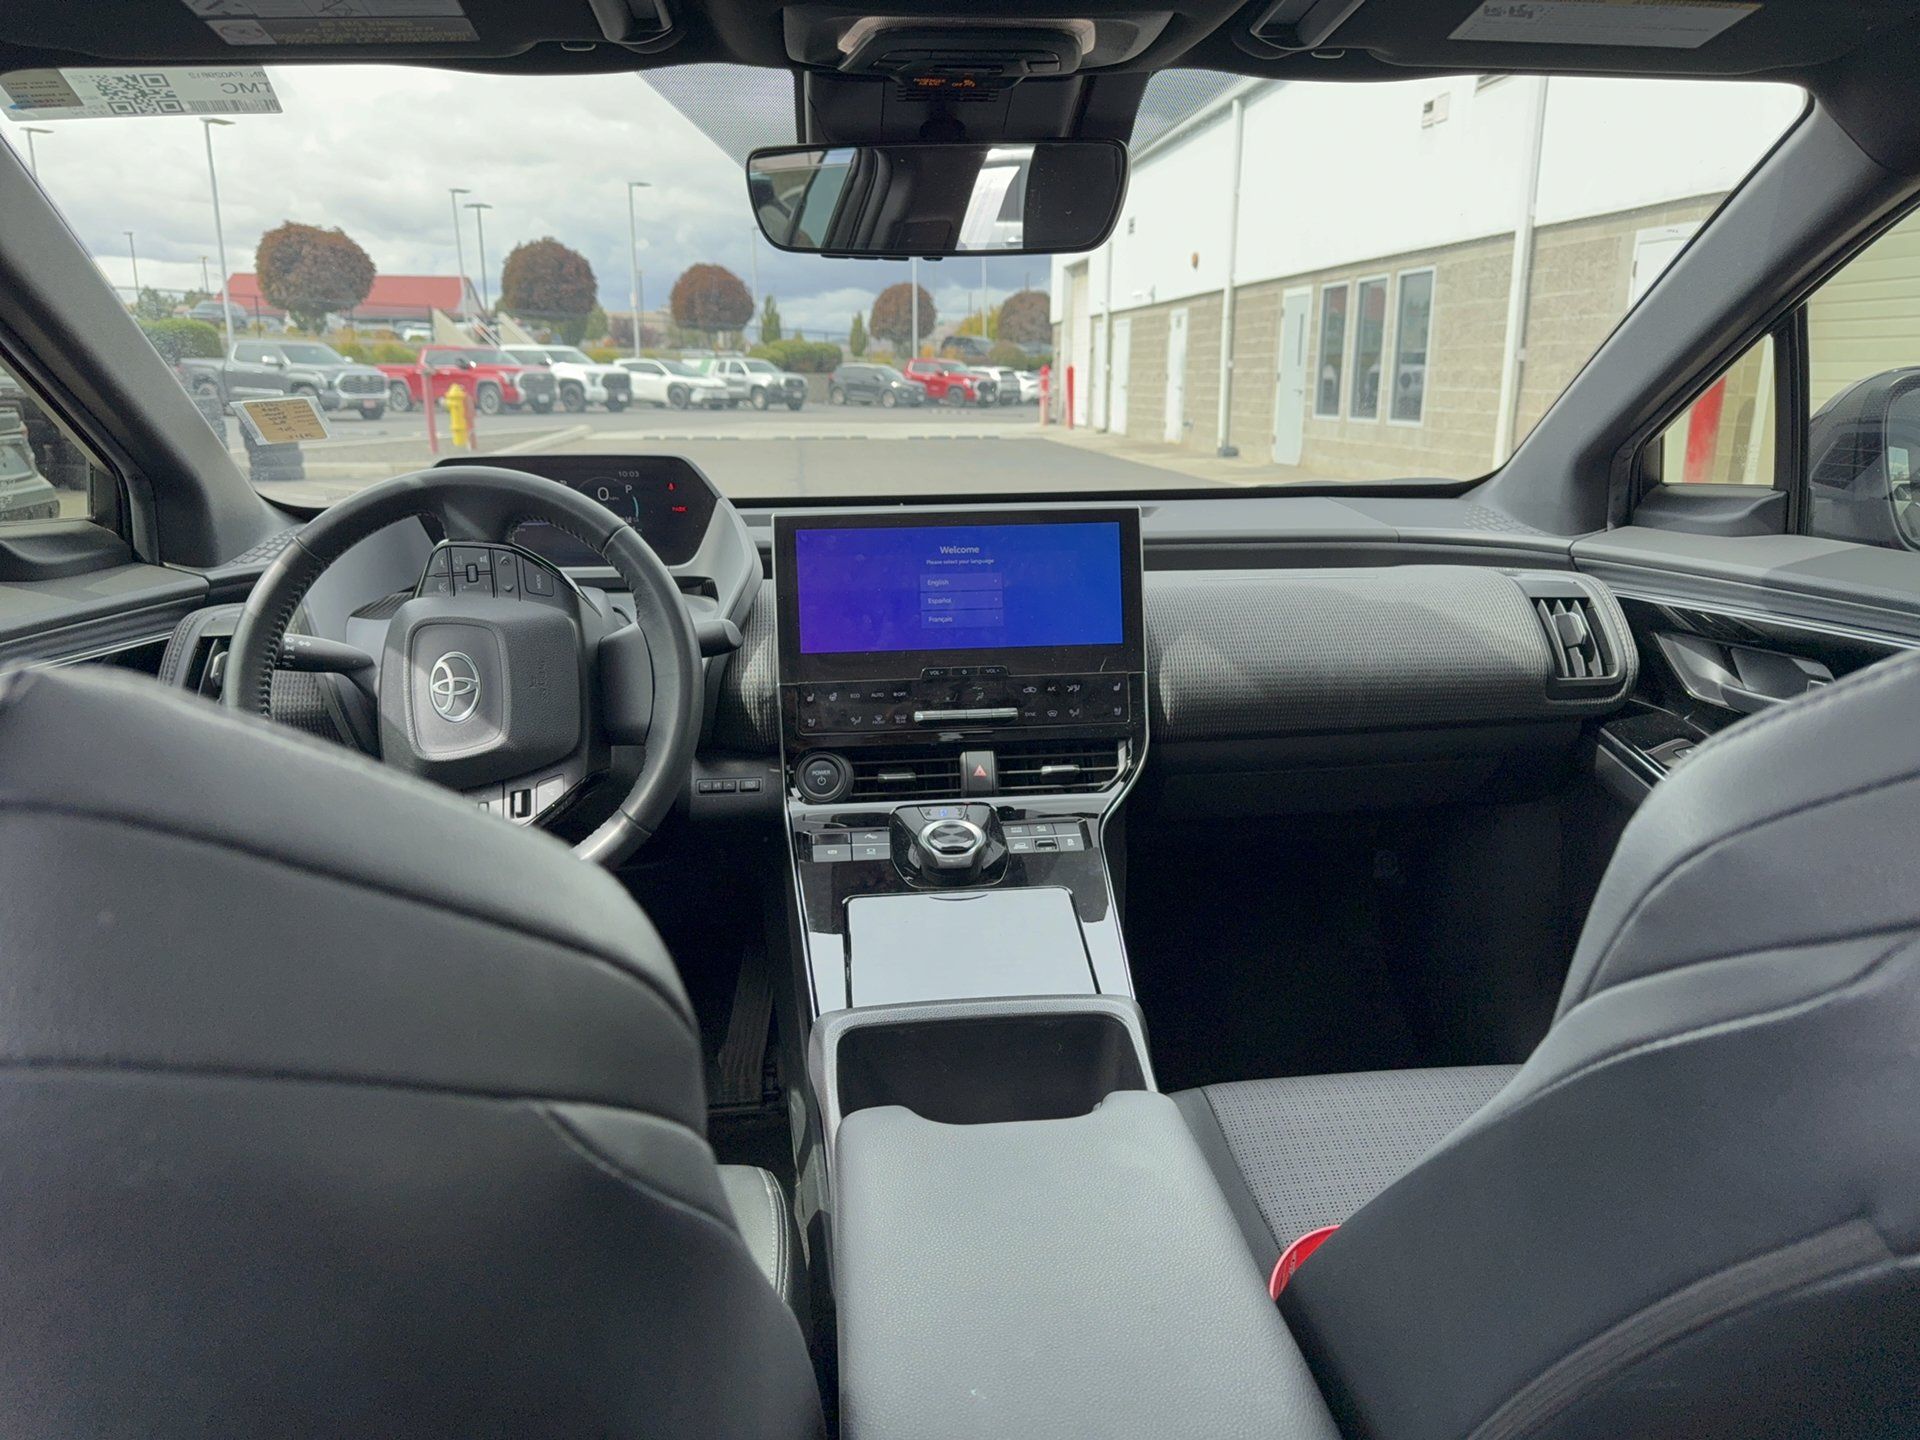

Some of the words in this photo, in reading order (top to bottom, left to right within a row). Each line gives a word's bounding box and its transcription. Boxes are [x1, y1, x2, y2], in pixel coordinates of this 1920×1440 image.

[625, 484, 632, 493] P
[597, 486, 609, 501] 0
[939, 546, 980, 554] Welcome
[970, 558, 994, 566] language
[927, 579, 949, 587] English
[927, 597, 951, 605] Español
[928, 615, 952, 624] Français
